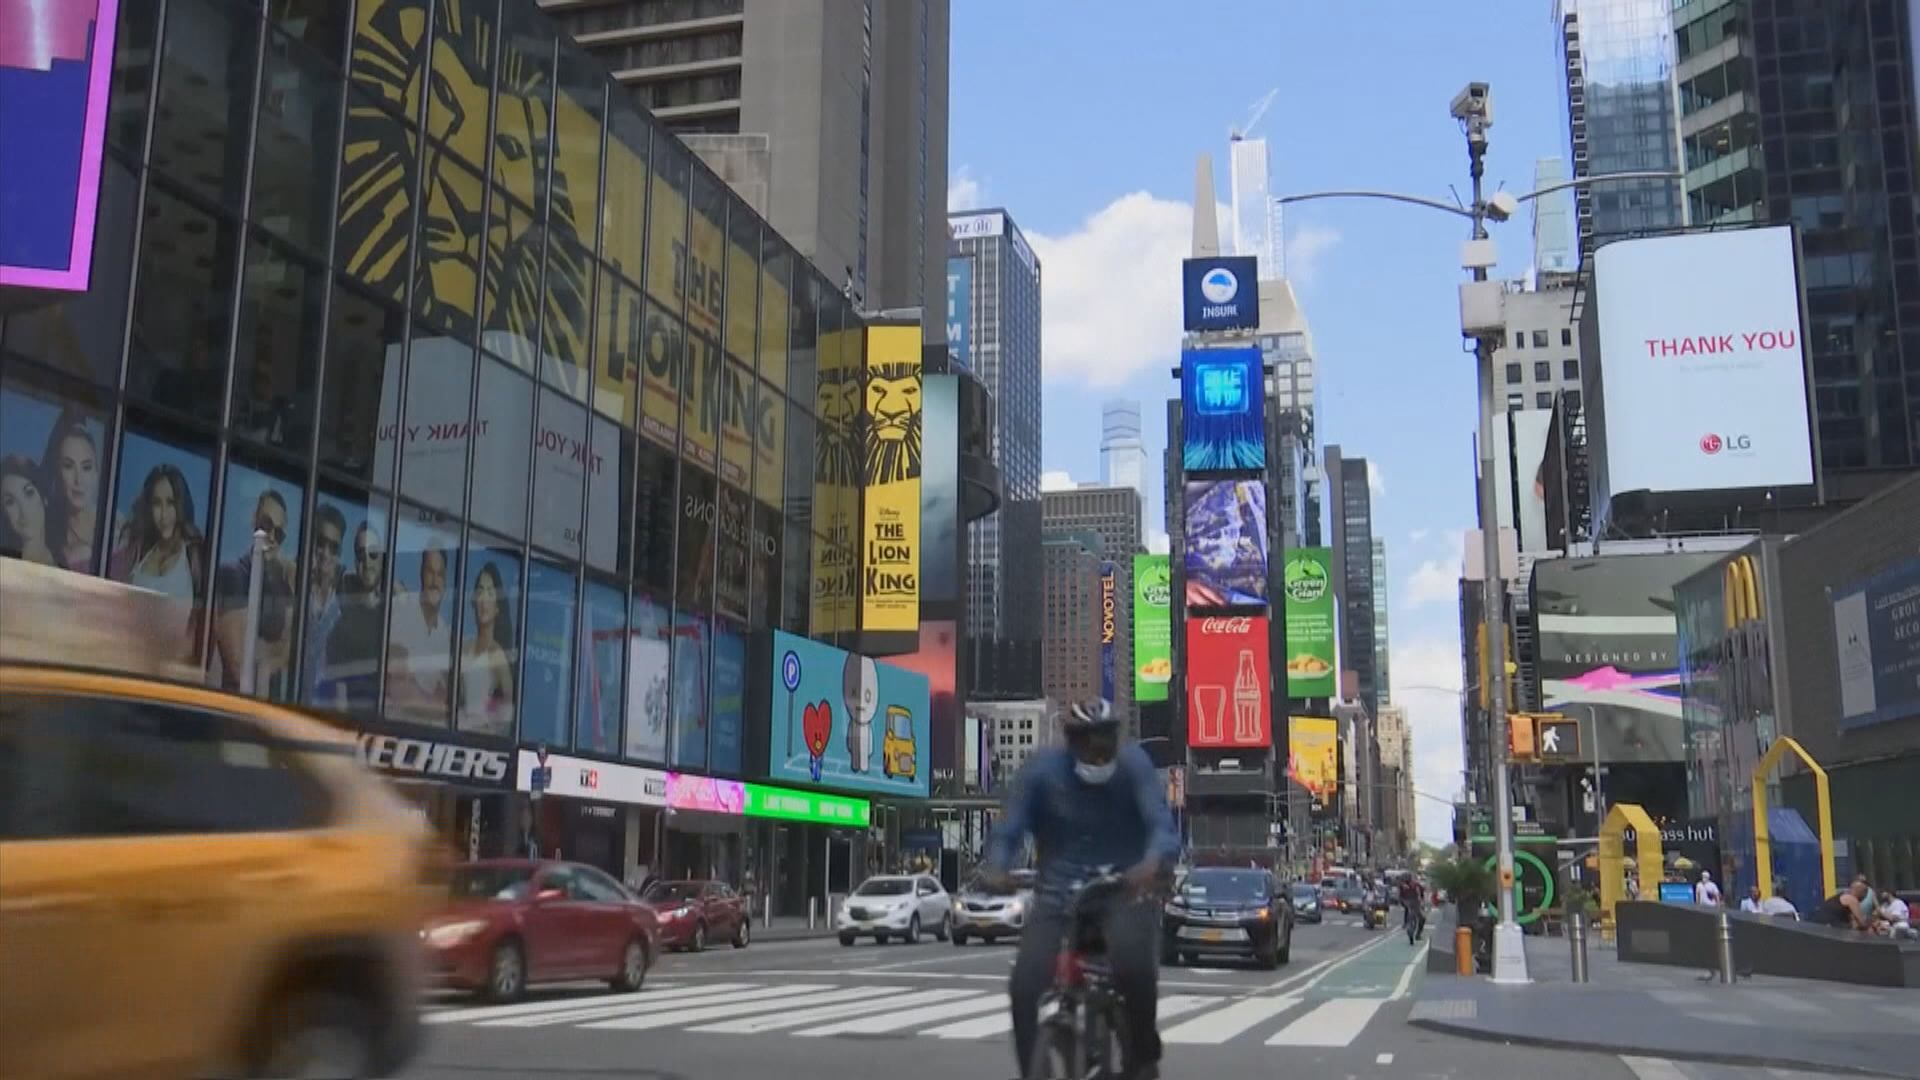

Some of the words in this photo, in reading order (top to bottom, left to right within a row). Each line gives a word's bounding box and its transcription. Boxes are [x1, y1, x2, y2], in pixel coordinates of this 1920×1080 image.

[672, 237, 722, 316] THE
[608, 258, 697, 401] LION
[1645, 335, 1734, 357] THANK
[1742, 330, 1796, 350] YOU
[1727, 435, 1751, 450] LG
[875, 523, 904, 538] THE
[869, 540, 910, 565] LION
[866, 566, 916, 596] KING
[1102, 572, 1114, 643] NOVOTEL
[1565, 652, 1640, 663] DESIGNED
[1650, 651, 1666, 661] BY
[1687, 825, 1714, 841] hut
